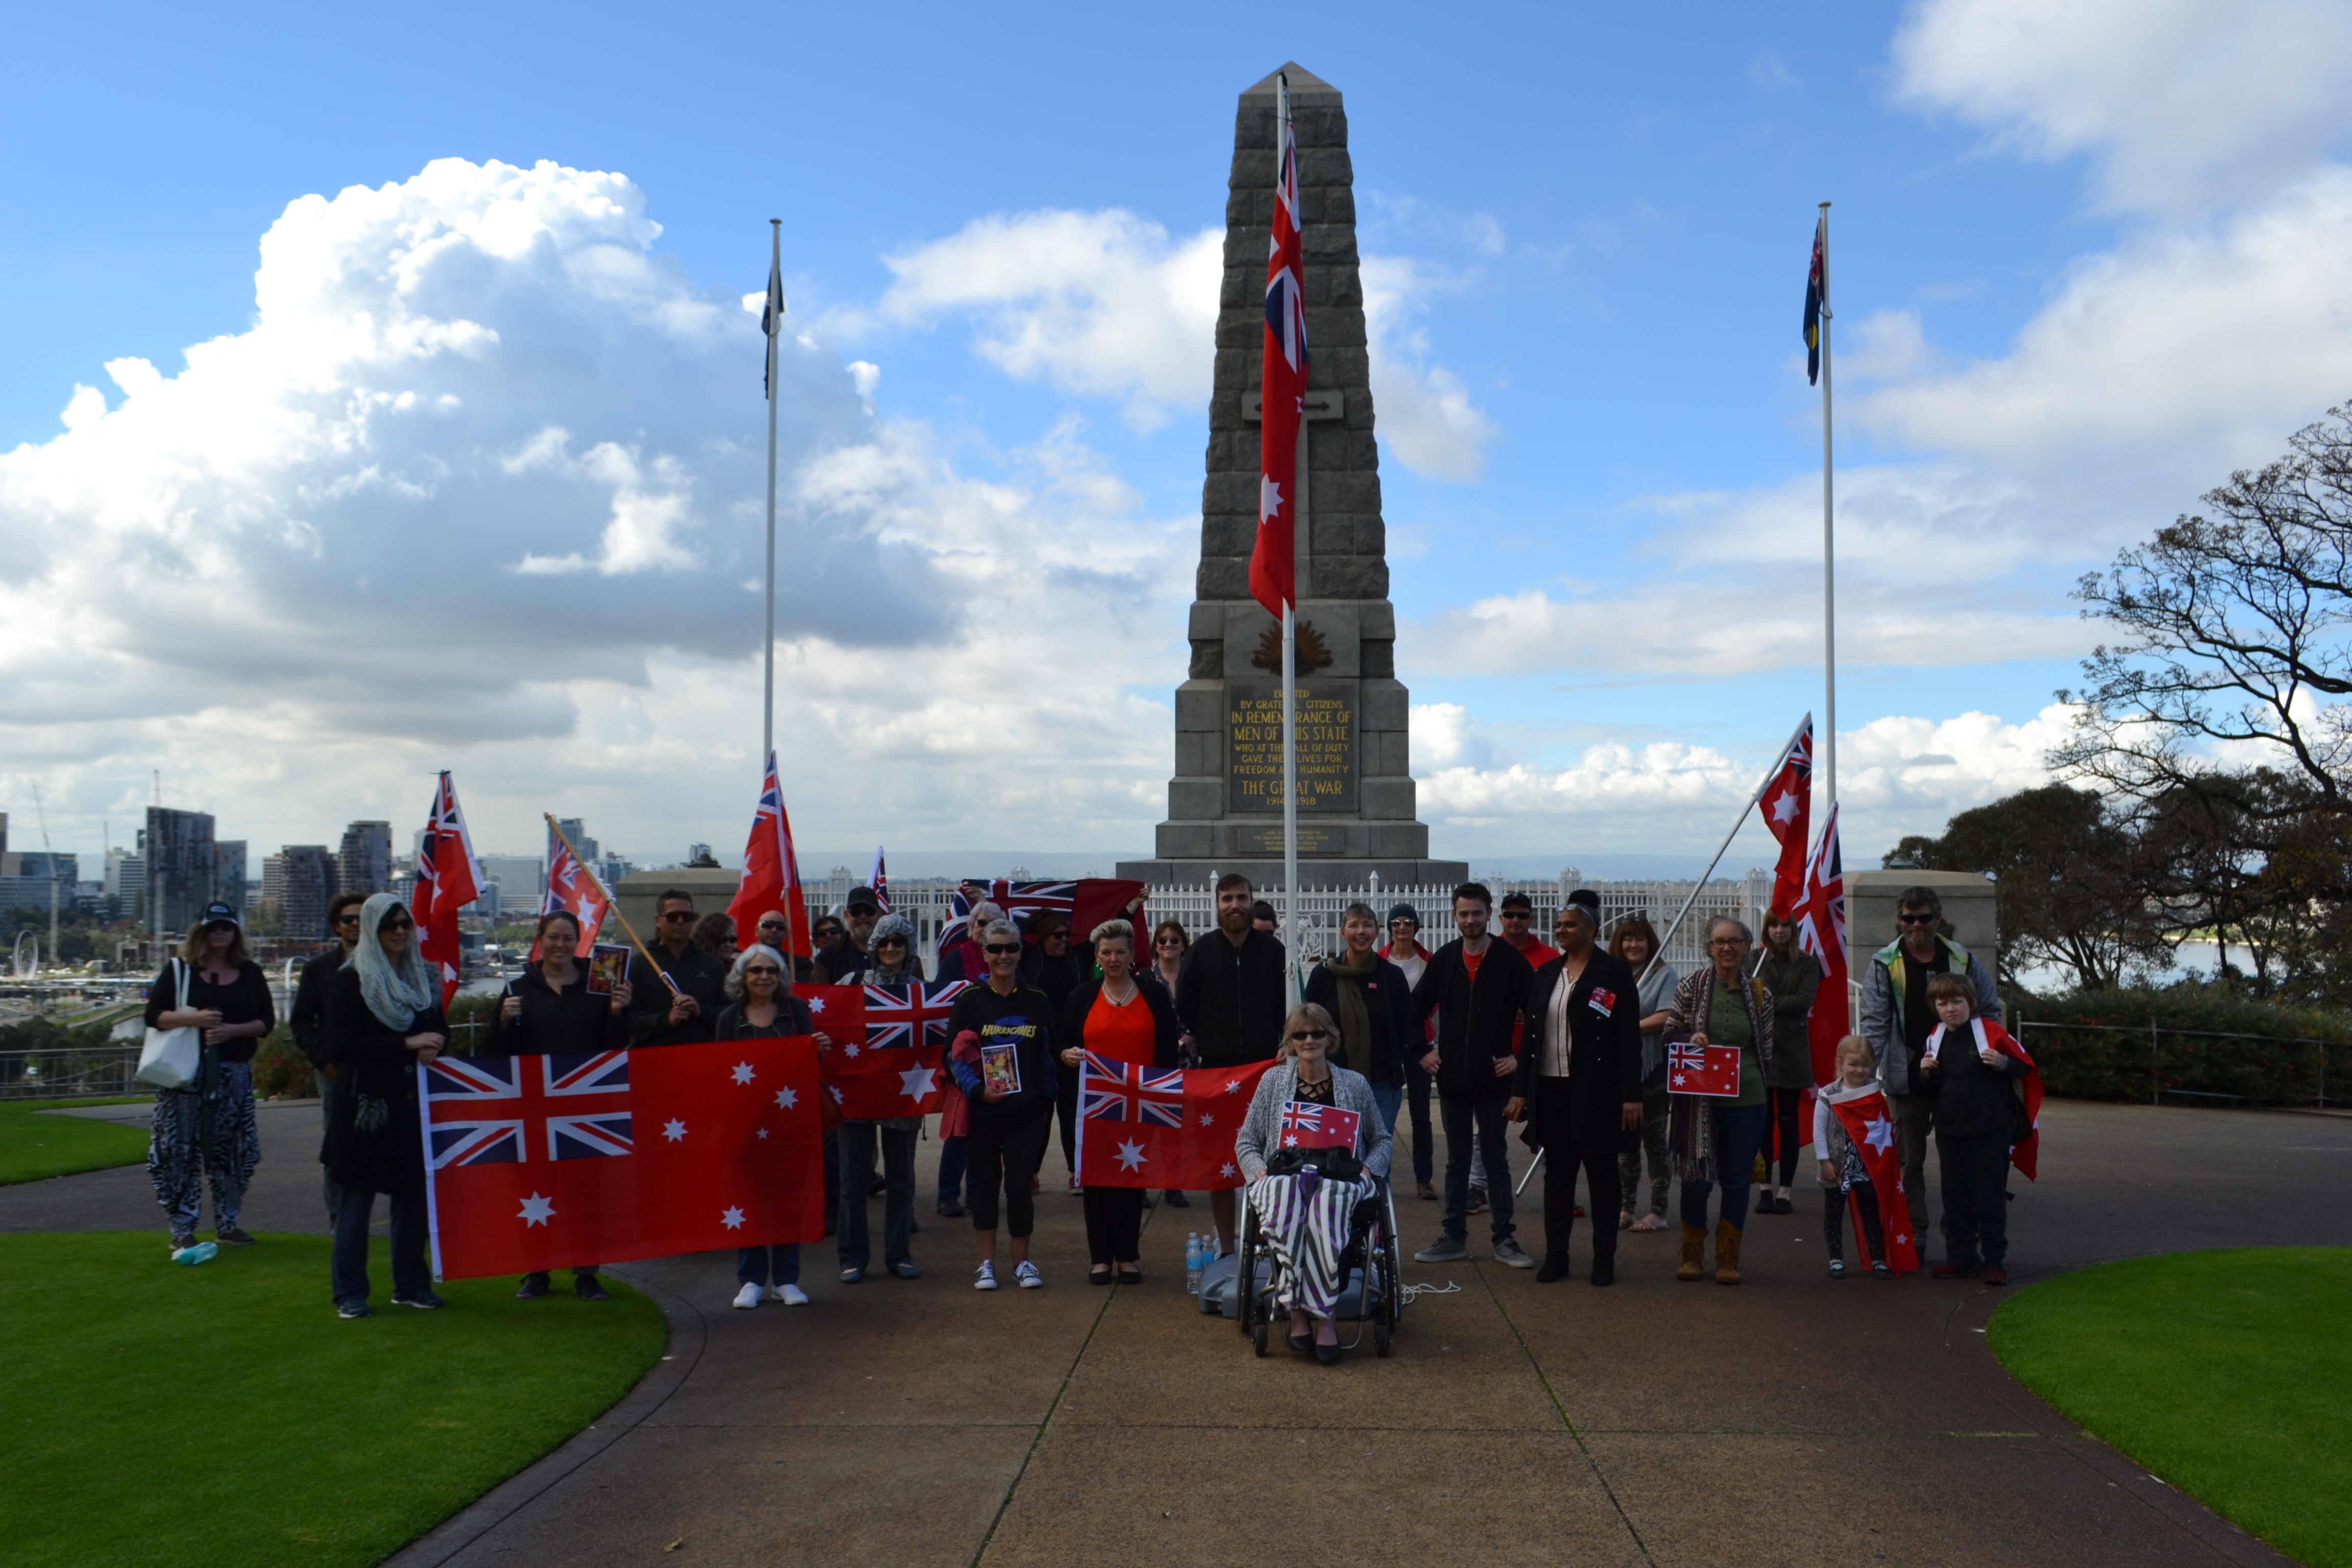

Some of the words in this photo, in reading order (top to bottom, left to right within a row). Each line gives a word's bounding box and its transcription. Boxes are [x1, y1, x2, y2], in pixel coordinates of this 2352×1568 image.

[1274, 690, 1309, 698] ERTED
[1241, 700, 1252, 708] BY
[1256, 700, 1300, 708] GRATEL
[1306, 700, 1342, 708] CITIZENS
[1232, 711, 1242, 723] IN
[1247, 711, 1332, 723] REMEMRANCE
[1337, 711, 1351, 723] OF
[1235, 726, 1260, 740] MEN
[1264, 726, 1280, 740] OF
[1313, 726, 1348, 740] STATE
[1235, 744, 1254, 752] WHO
[1257, 744, 1266, 752] AT
[1295, 744, 1309, 752] ALL
[1312, 744, 1322, 752] OF
[1326, 744, 1349, 752] DUTY
[1242, 754, 1264, 763] GAVE
[1267, 754, 1284, 763] THE
[1296, 754, 1321, 763] LIVES
[1325, 754, 1342, 763] FOR
[1234, 766, 1276, 774] FREEDOM
[1300, 765, 1349, 774] HUMANITY
[1241, 781, 1266, 795] THE
[1270, 781, 1310, 795] GRAT
[1314, 781, 1342, 795] WAR
[1296, 797, 1316, 805] 1918
[981, 1024, 1037, 1038] HURRICANES
